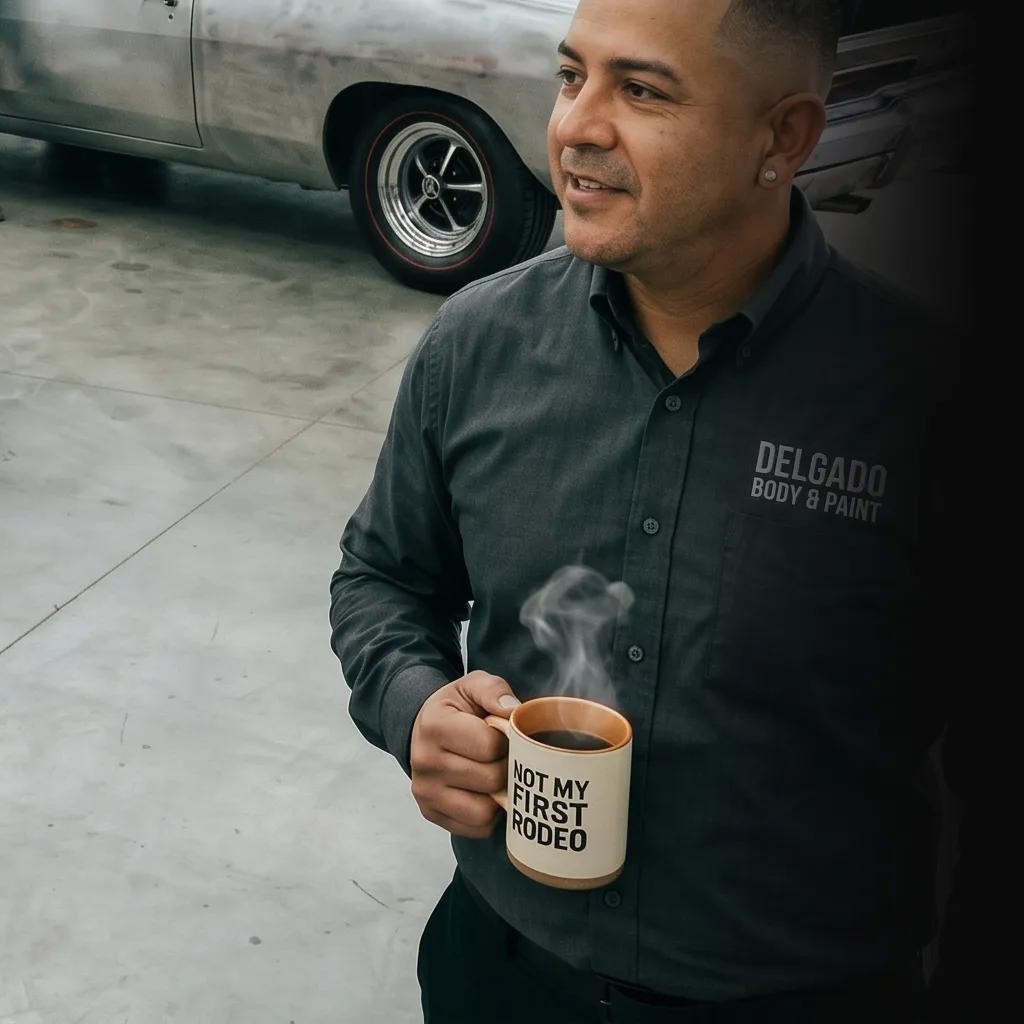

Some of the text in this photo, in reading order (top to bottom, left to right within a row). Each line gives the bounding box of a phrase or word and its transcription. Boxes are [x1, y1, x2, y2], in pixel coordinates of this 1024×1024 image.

[755, 440, 888, 498] DELGADO
[750, 477, 883, 523] BODY & PAINT
[513, 759, 590, 800] NOT MY
[513, 782, 588, 826] FIRST
[512, 808, 587, 852] RODEO
